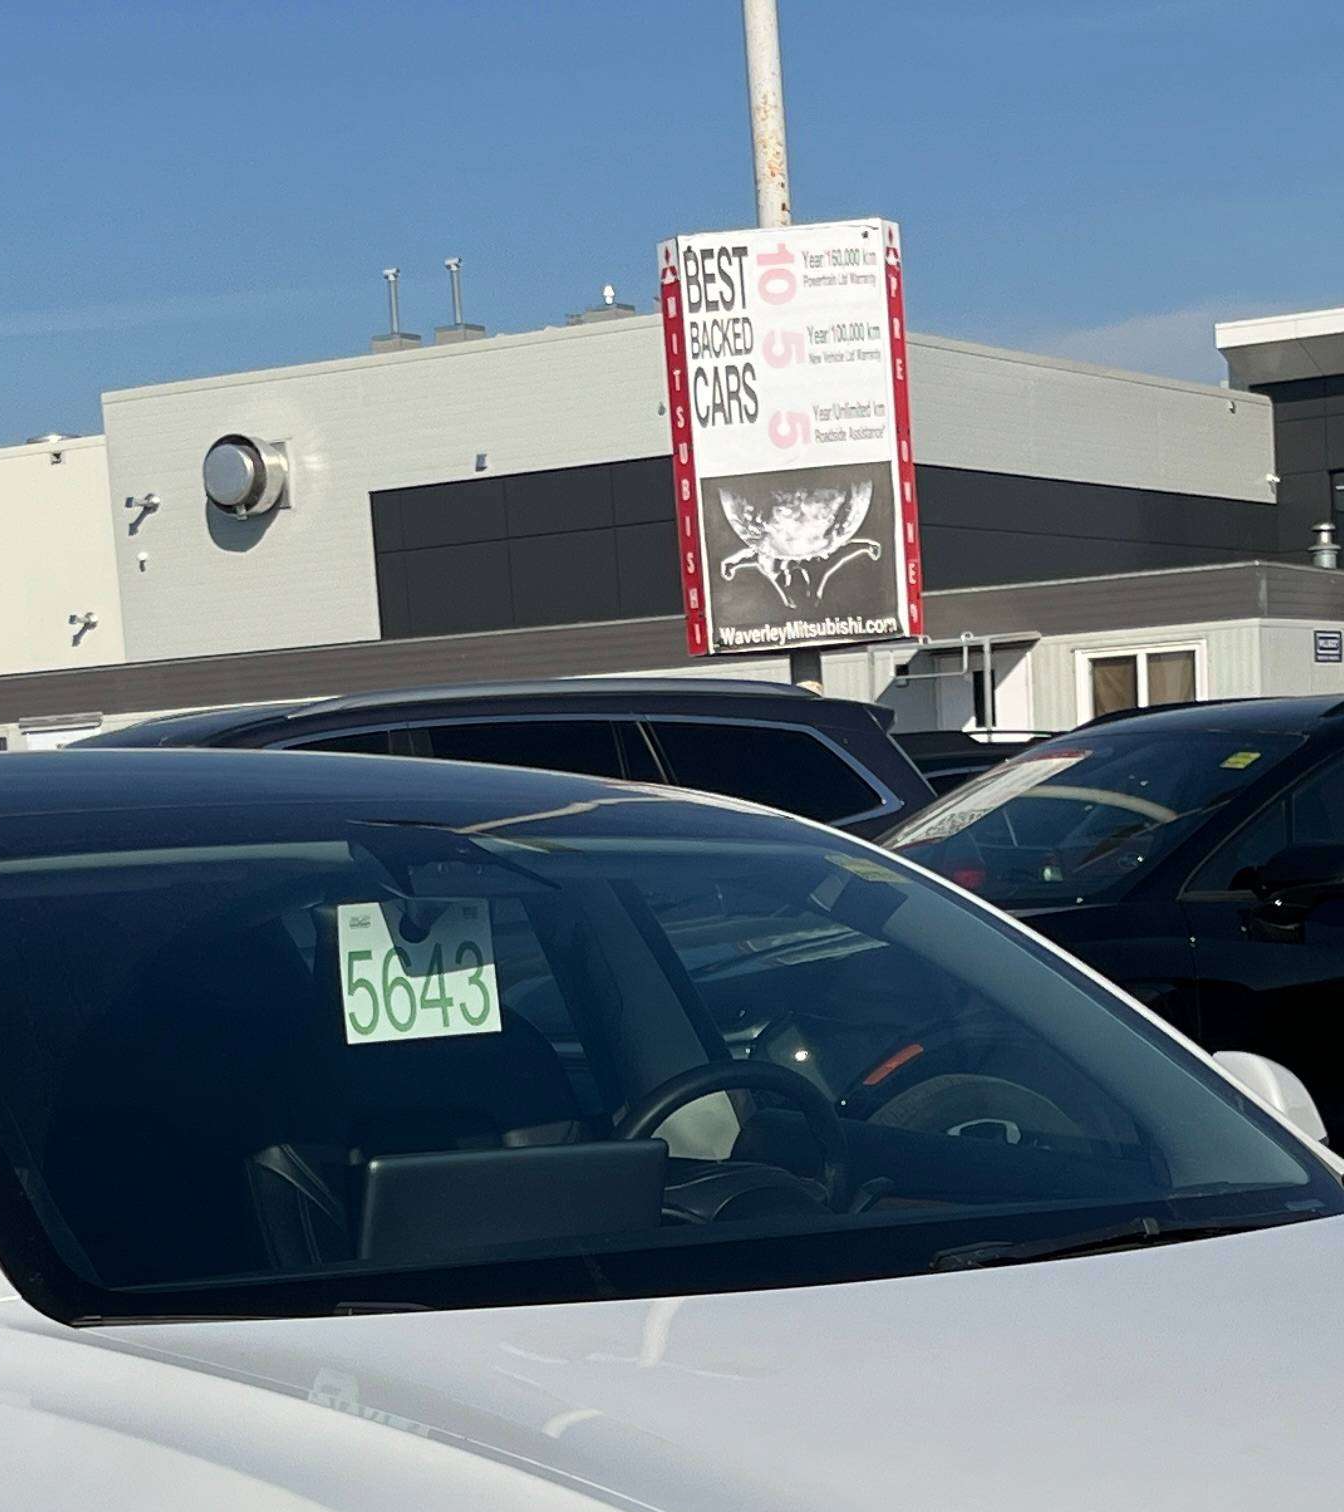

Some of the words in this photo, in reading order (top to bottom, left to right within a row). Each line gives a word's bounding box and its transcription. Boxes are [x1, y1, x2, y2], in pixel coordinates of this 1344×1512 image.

[802, 250, 824, 269] Year
[683, 246, 748, 313] BEST
[690, 317, 754, 359] BACKED
[807, 324, 828, 345] Year
[693, 362, 759, 428] CARS
[812, 404, 832, 421] Year
[719, 616, 898, 645] WaverleyMitsubishi.com
[347, 940, 491, 1036] 5643
